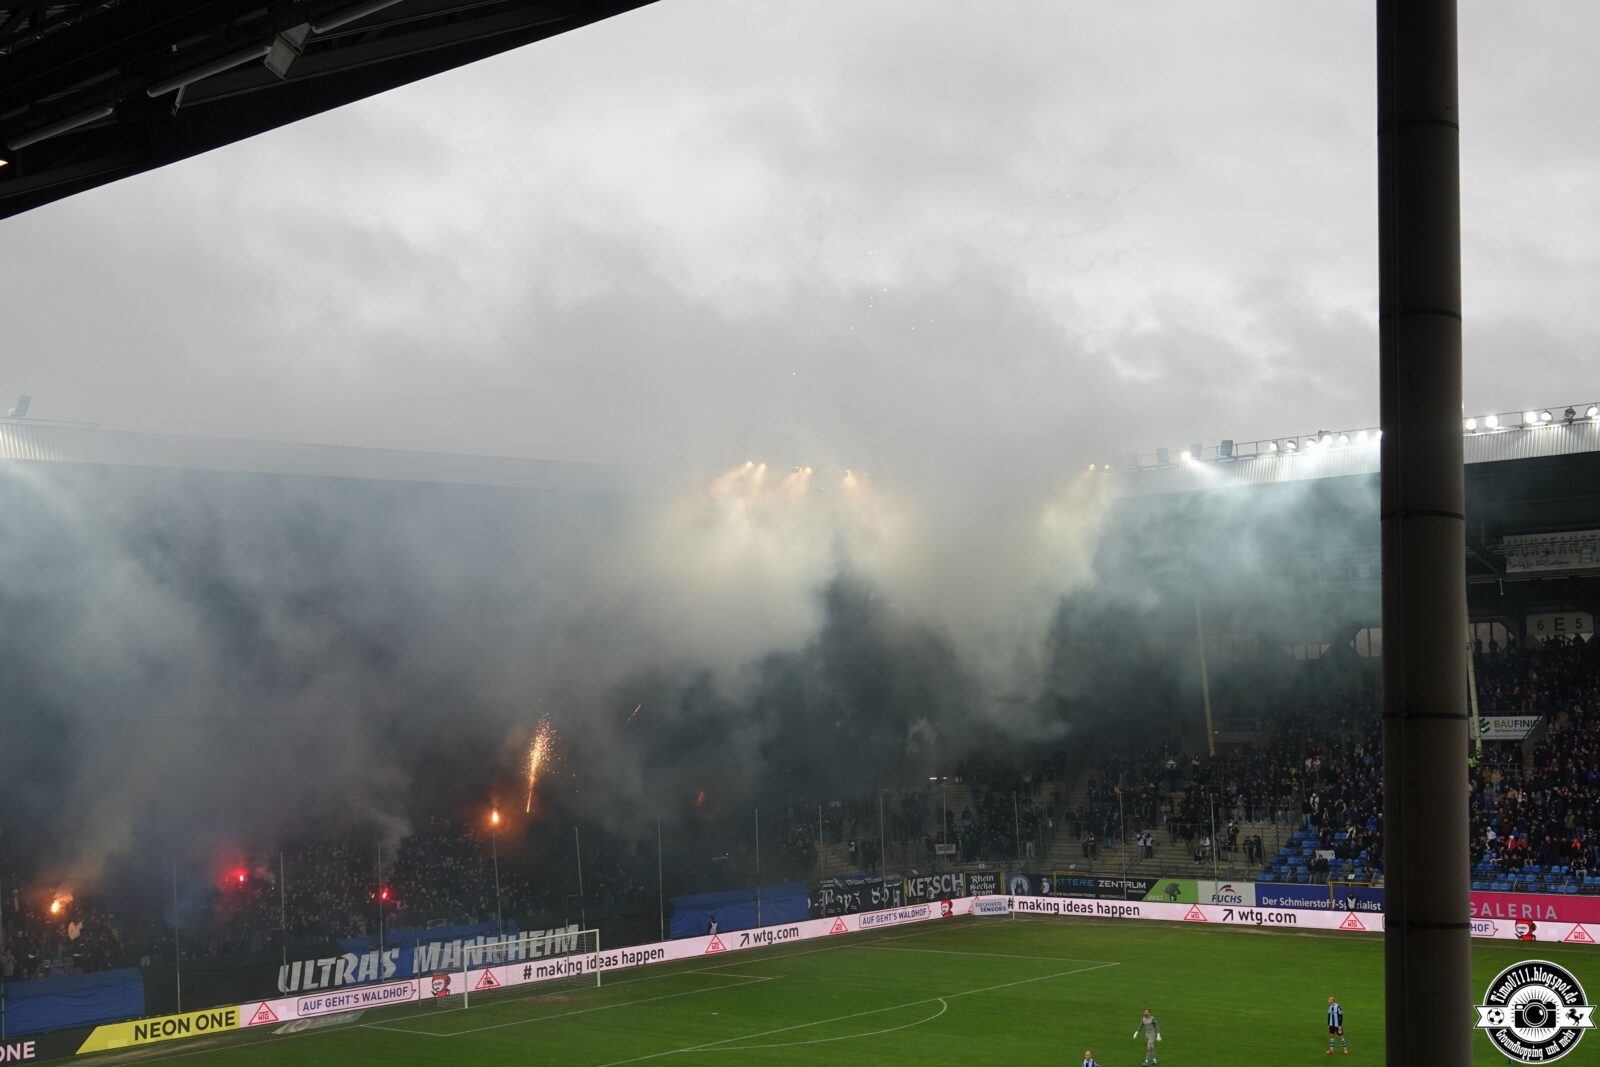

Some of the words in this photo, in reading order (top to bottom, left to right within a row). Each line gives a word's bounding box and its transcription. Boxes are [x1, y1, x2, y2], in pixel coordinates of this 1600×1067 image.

[1537, 620, 1544, 630] 6
[1554, 617, 1565, 631] E
[1575, 618, 1582, 629] 5
[908, 872, 964, 898] KETSCH
[1098, 880, 1146, 889] ZENTRUM
[1018, 898, 1060, 915] making
[1063, 900, 1094, 913] ideas
[1097, 902, 1140, 918] happen
[1211, 894, 1242, 904] FUCHS
[1262, 897, 1277, 906] Der
[862, 915, 875, 925] AUF
[876, 911, 897, 923] GEHT'S
[898, 908, 928, 921] WALDHOF
[1238, 909, 1297, 925] wtg.com
[752, 926, 799, 945] wtg.com
[277, 947, 400, 993] ULTRAS
[412, 924, 580, 974] MANNHEIM
[523, 965, 532, 980] #
[536, 959, 582, 979] making
[586, 953, 619, 969] ideas
[621, 946, 664, 967] happen
[302, 999, 323, 1012] AUF
[325, 992, 359, 1008] GEHT'S
[361, 986, 409, 1003] WALDHOF
[134, 1017, 191, 1041] NEON
[195, 1010, 236, 1031] ONE
